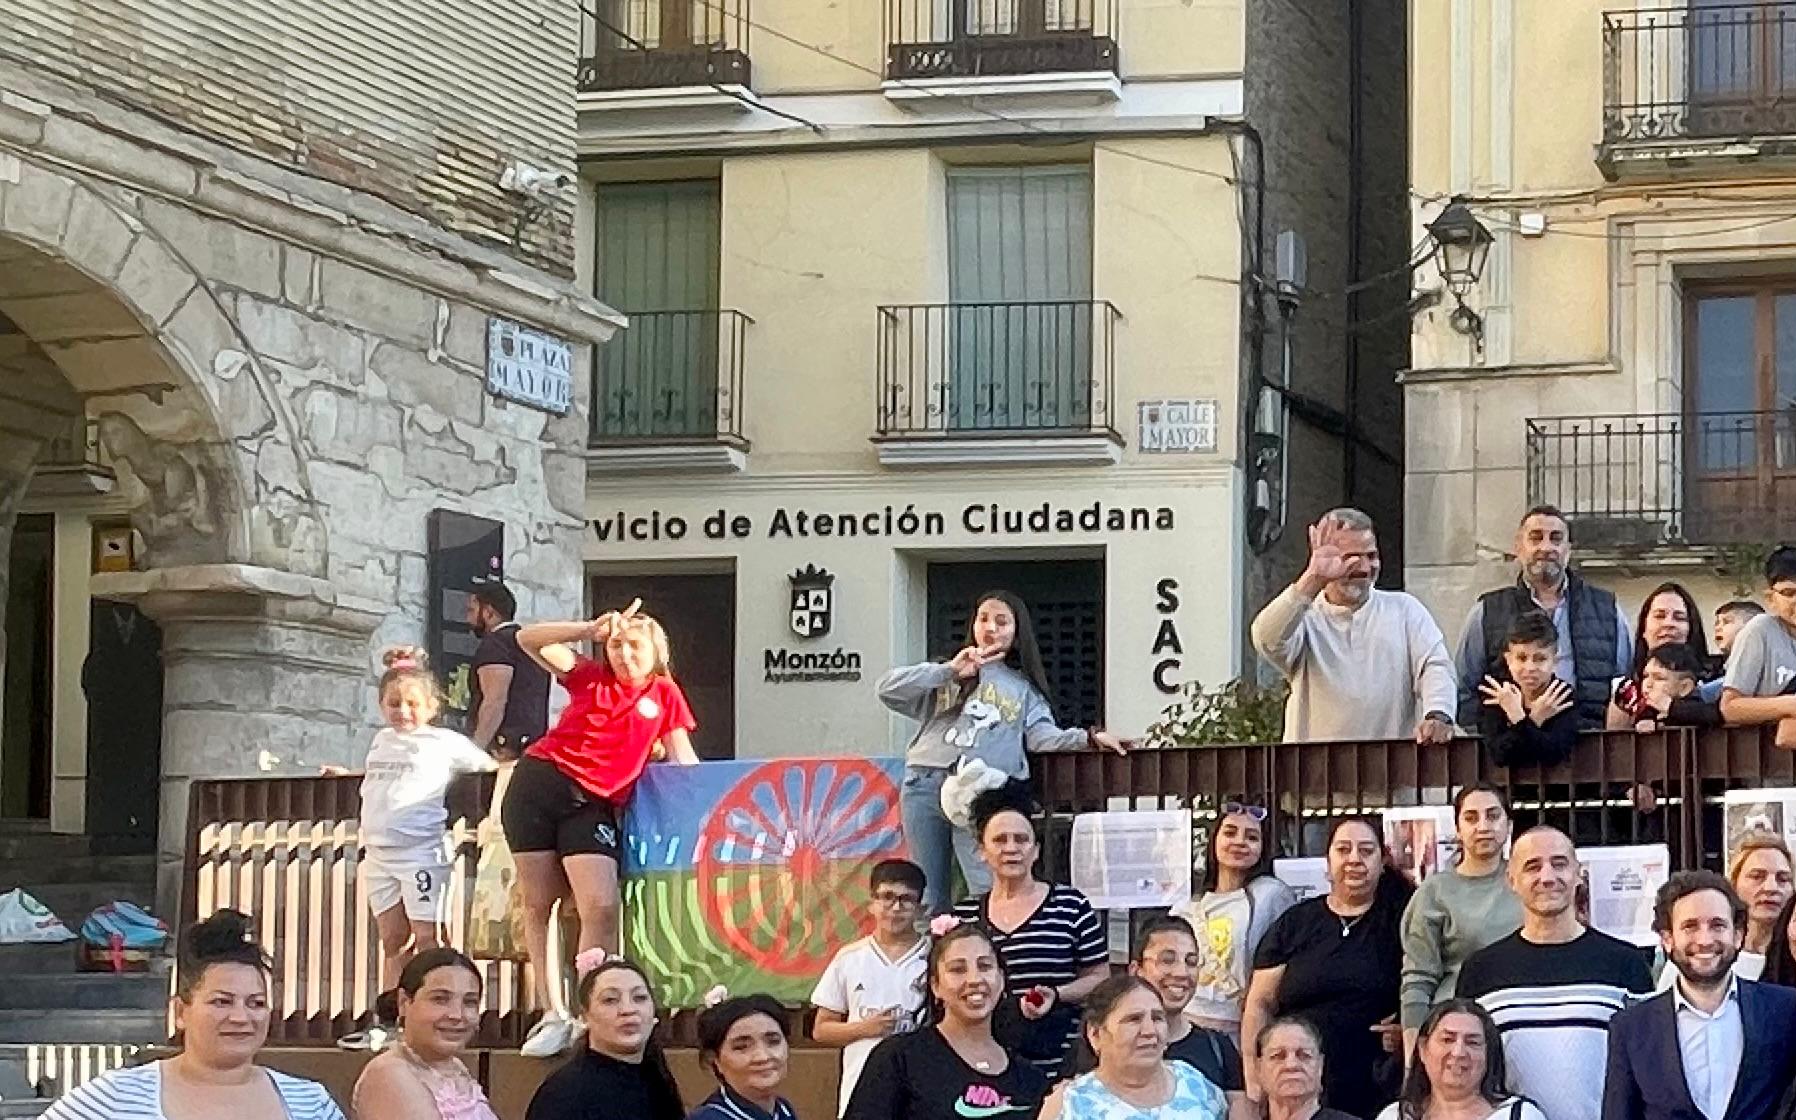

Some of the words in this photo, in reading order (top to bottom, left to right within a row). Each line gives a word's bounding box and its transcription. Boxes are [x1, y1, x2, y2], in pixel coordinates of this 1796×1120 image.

[519, 339, 570, 371] PLAZA
[491, 360, 568, 402] MAYOR
[1167, 407, 1210, 424] CALLE
[1148, 426, 1209, 446] MAYOR
[585, 509, 689, 541] vicio
[703, 508, 752, 539] de
[767, 503, 944, 538] Atención
[962, 501, 1174, 533] Ciudadana
[1150, 577, 1183, 694] SAC
[764, 647, 861, 669] Monzón
[415, 868, 432, 893] 9
